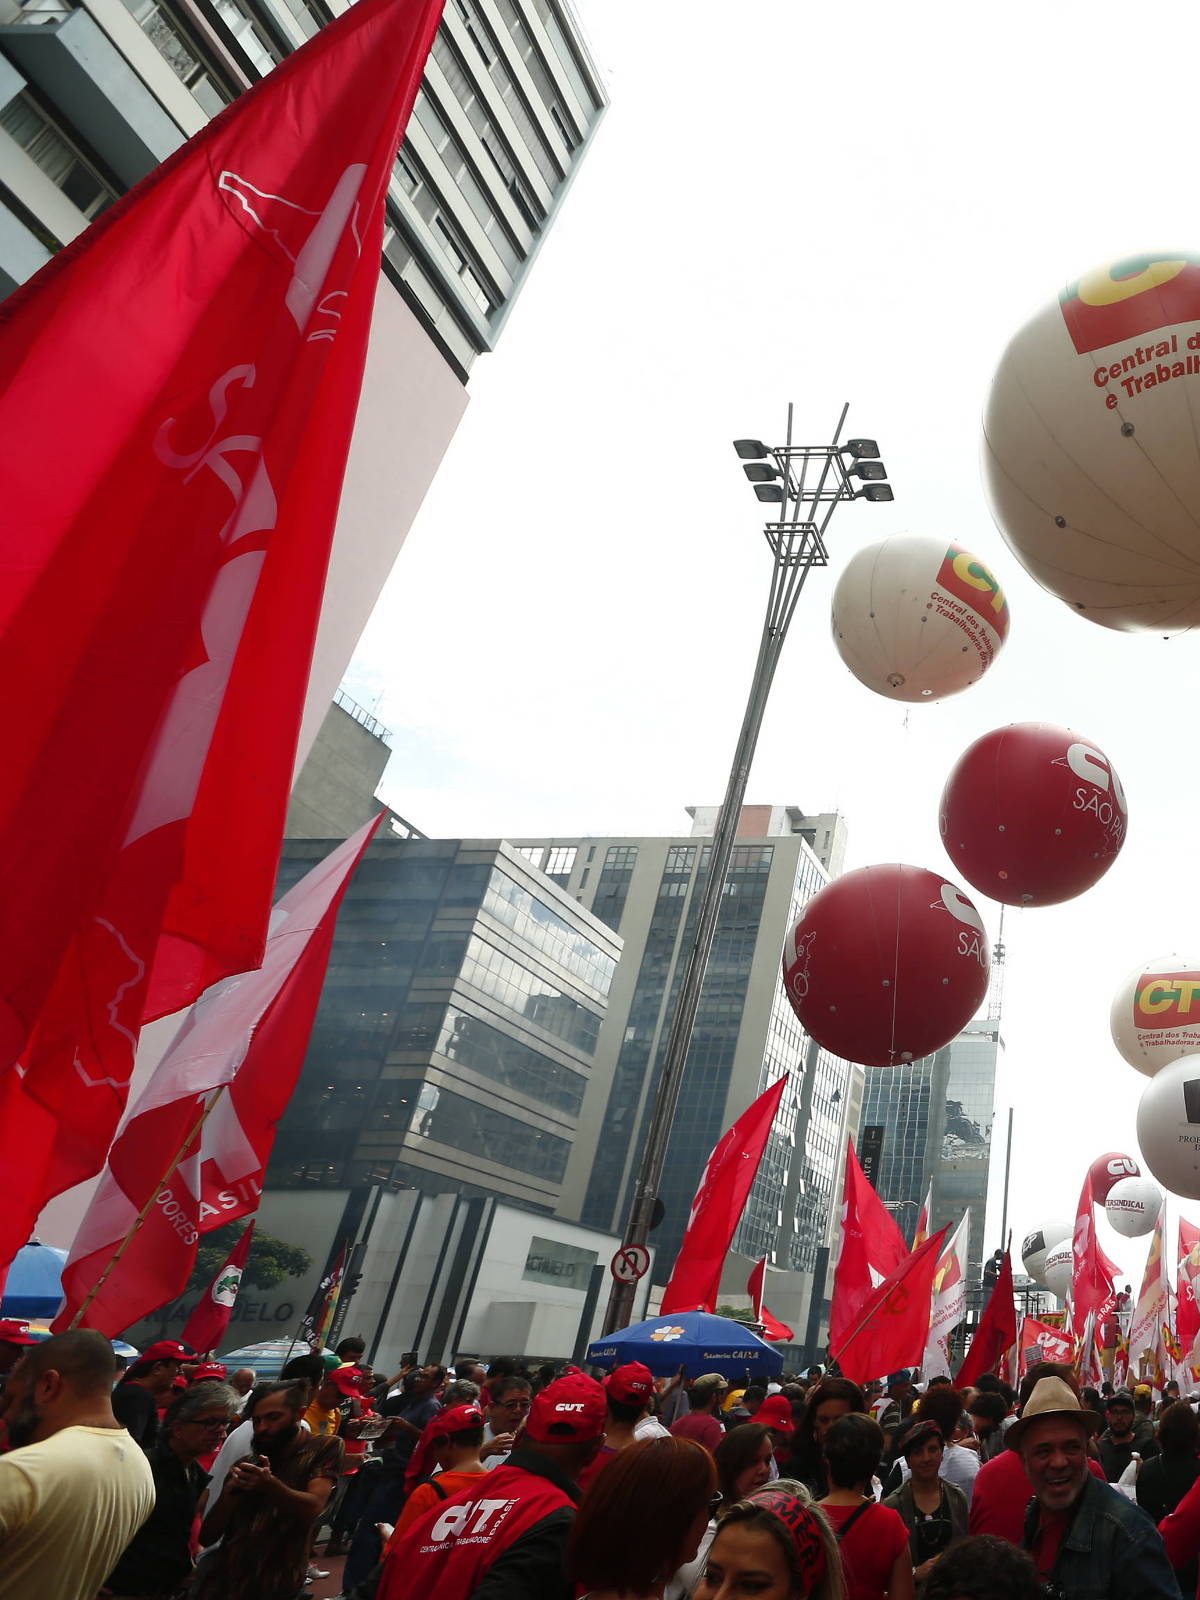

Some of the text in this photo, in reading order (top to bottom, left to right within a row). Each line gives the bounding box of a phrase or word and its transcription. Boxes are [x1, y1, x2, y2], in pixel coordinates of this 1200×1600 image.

[1093, 334, 1178, 388] Central
[1105, 393, 1119, 410] e
[930, 591, 980, 631] Central dos
[926, 602, 934, 610] e
[935, 604, 982, 651] Trabalhadoras
[1073, 788, 1113, 824] SÃO
[1137, 1032, 1164, 1041] Central
[1166, 1031, 1180, 1039] dos
[732, 1350, 759, 1359] CAIXA
[632, 1382, 648, 1391] CUT
[555, 1402, 585, 1413] CUT
